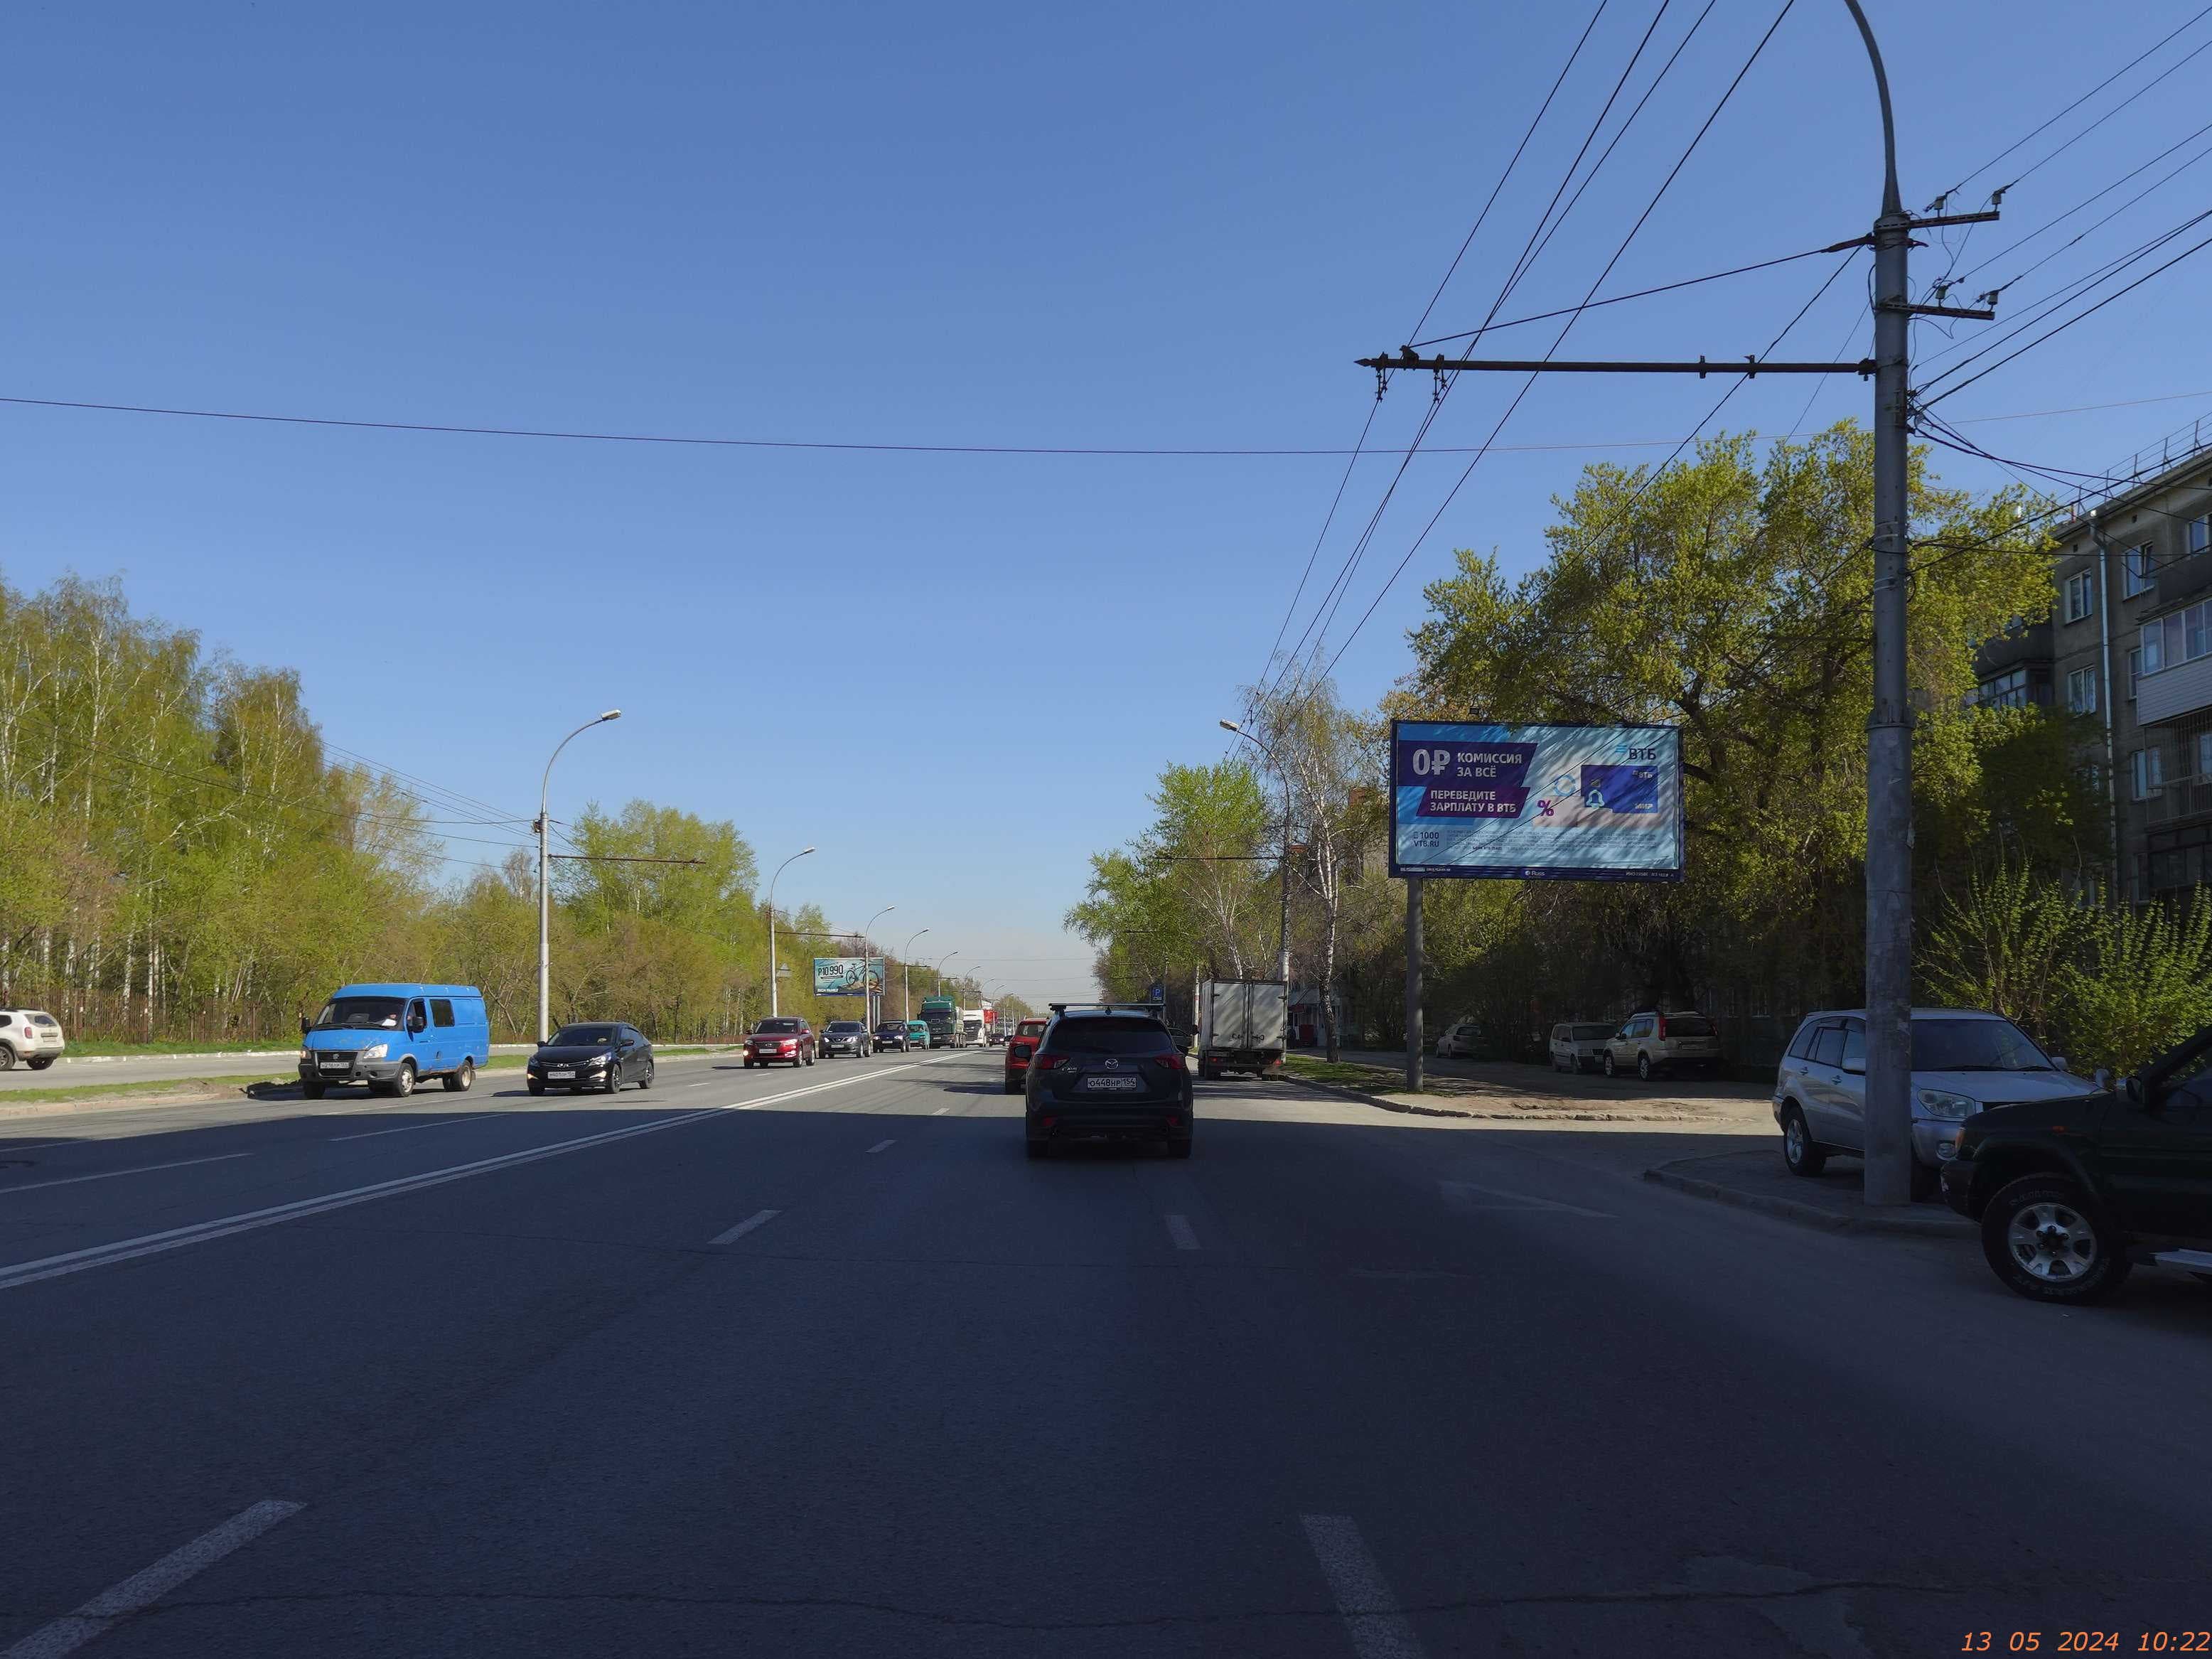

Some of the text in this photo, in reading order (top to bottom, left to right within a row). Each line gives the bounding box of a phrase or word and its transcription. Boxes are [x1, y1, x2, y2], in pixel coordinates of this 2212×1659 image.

[1457, 752, 1522, 764] КОМИССИЯ
[1628, 748, 1657, 761] ВТБ
[1457, 765, 1496, 778] ЗА ВСЁ
[1430, 790, 1496, 802] ПЕРЕВЕДИТЕ
[1430, 802, 1517, 813] ЗАРПЛАТУ В ВТБ
